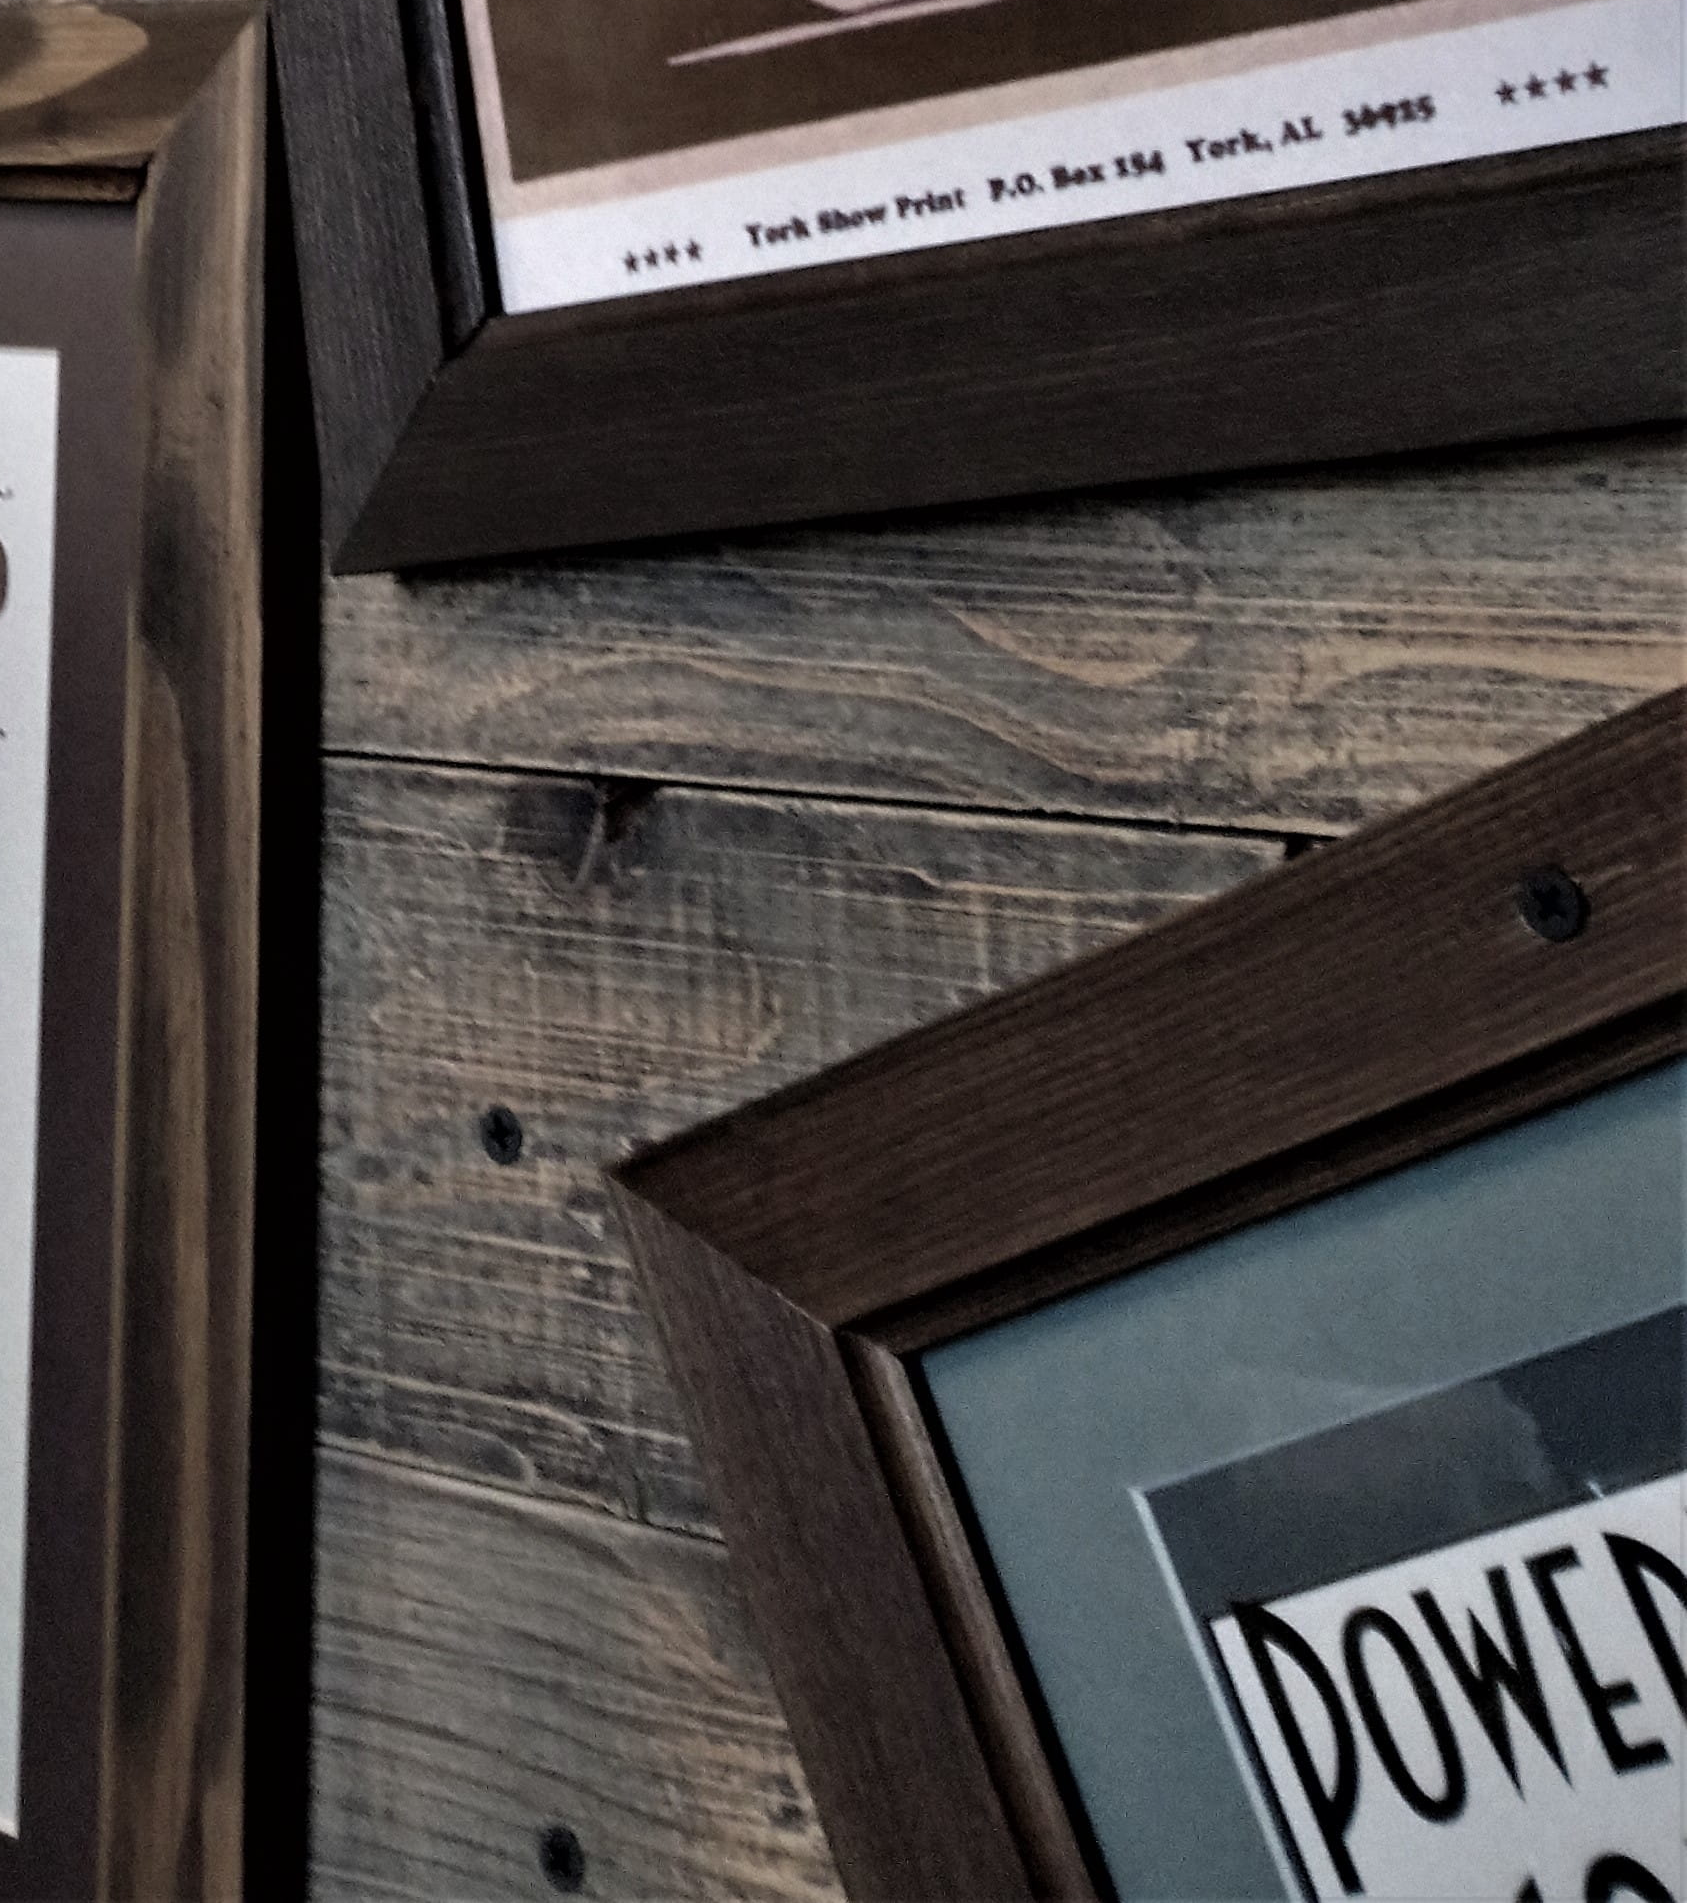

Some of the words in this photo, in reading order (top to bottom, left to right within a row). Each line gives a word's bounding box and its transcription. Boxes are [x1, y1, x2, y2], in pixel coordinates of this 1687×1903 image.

[894, 186, 967, 220] Print
[1049, 161, 1106, 191] Box
[1281, 115, 1324, 146] AL
